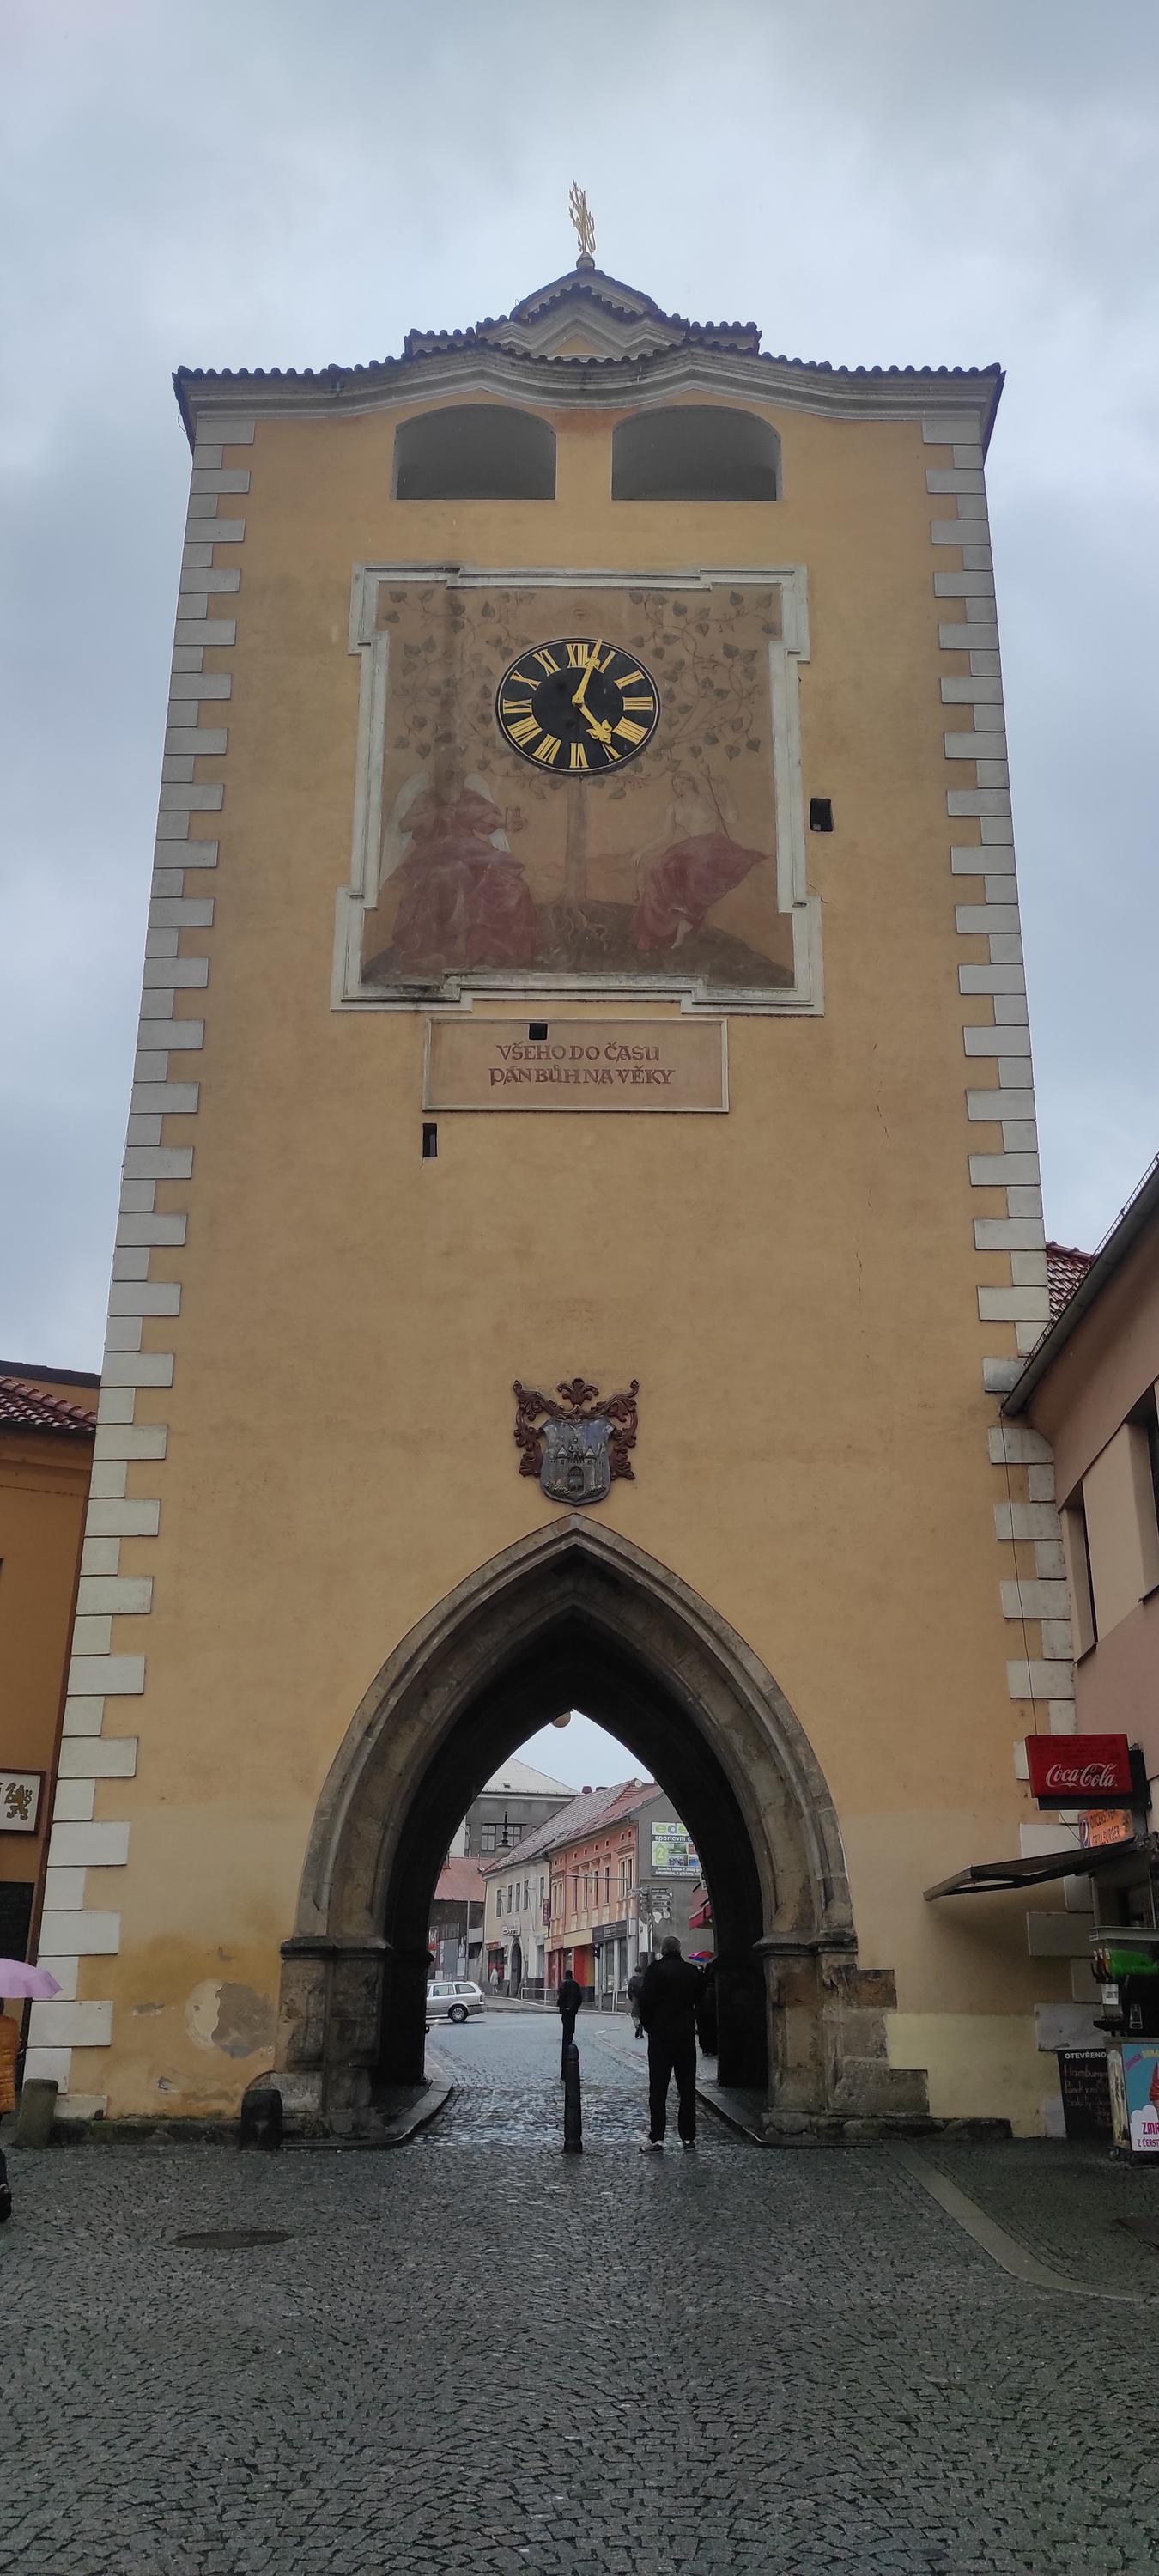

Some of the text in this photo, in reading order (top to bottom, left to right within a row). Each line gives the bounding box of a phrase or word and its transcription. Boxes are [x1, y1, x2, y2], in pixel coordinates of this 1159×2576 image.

[532, 648, 561, 677] XI
[566, 643, 591, 669] XII
[598, 650, 618, 673] I
[510, 670, 542, 691] X
[614, 670, 645, 690] II
[502, 698, 532, 714] IX
[622, 696, 653, 711] III
[507, 714, 543, 747] VIII
[532, 733, 562, 764] VII
[569, 742, 589, 769] VI
[495, 1041, 659, 1062] VŠEHO DO ČASU
[488, 1064, 676, 1086] PÁN BŮH NA VĚKY
[1046, 1763, 1118, 1788] Coca-Cola
